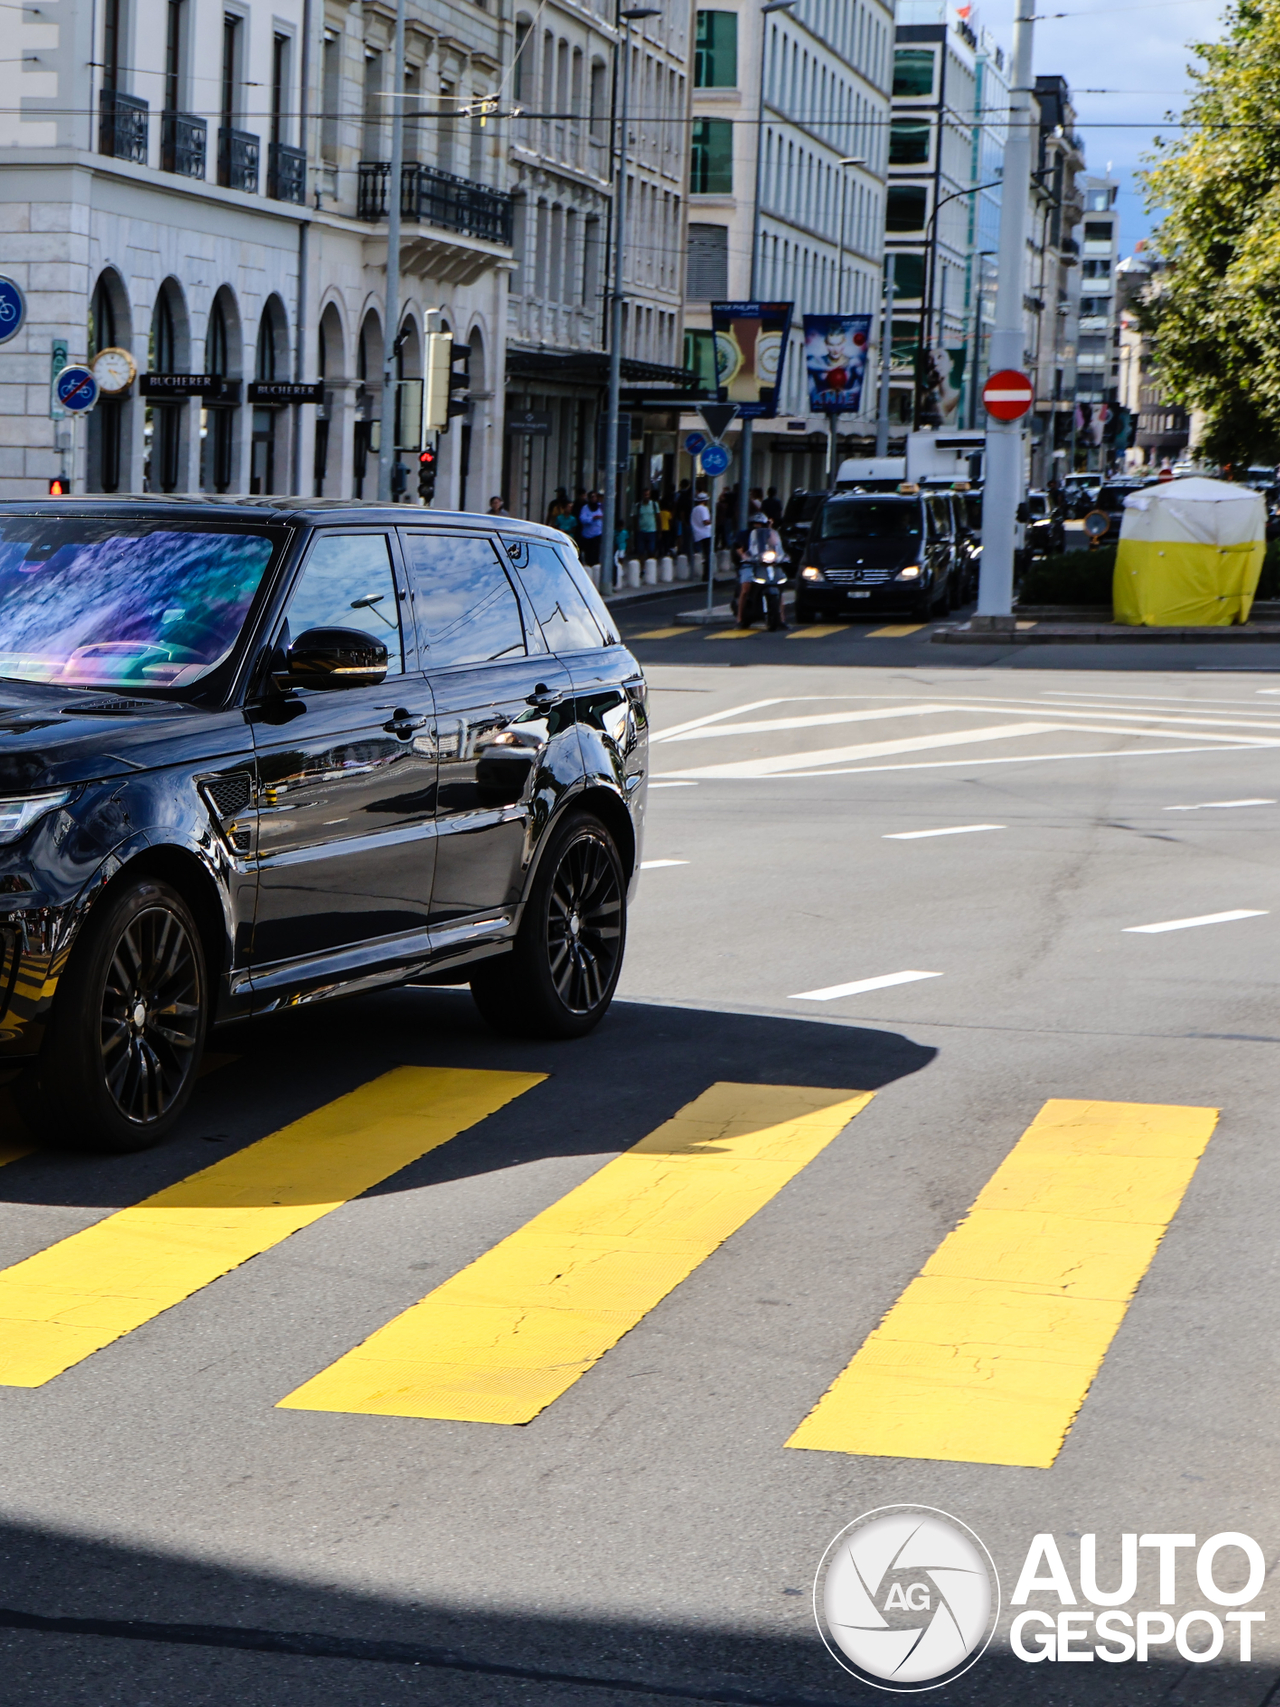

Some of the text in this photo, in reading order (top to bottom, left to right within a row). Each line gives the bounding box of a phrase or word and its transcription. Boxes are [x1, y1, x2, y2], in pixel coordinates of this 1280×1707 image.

[149, 376, 211, 386] BUCHERER
[257, 385, 315, 395] BUCHERER
[812, 390, 855, 404] KNIE
